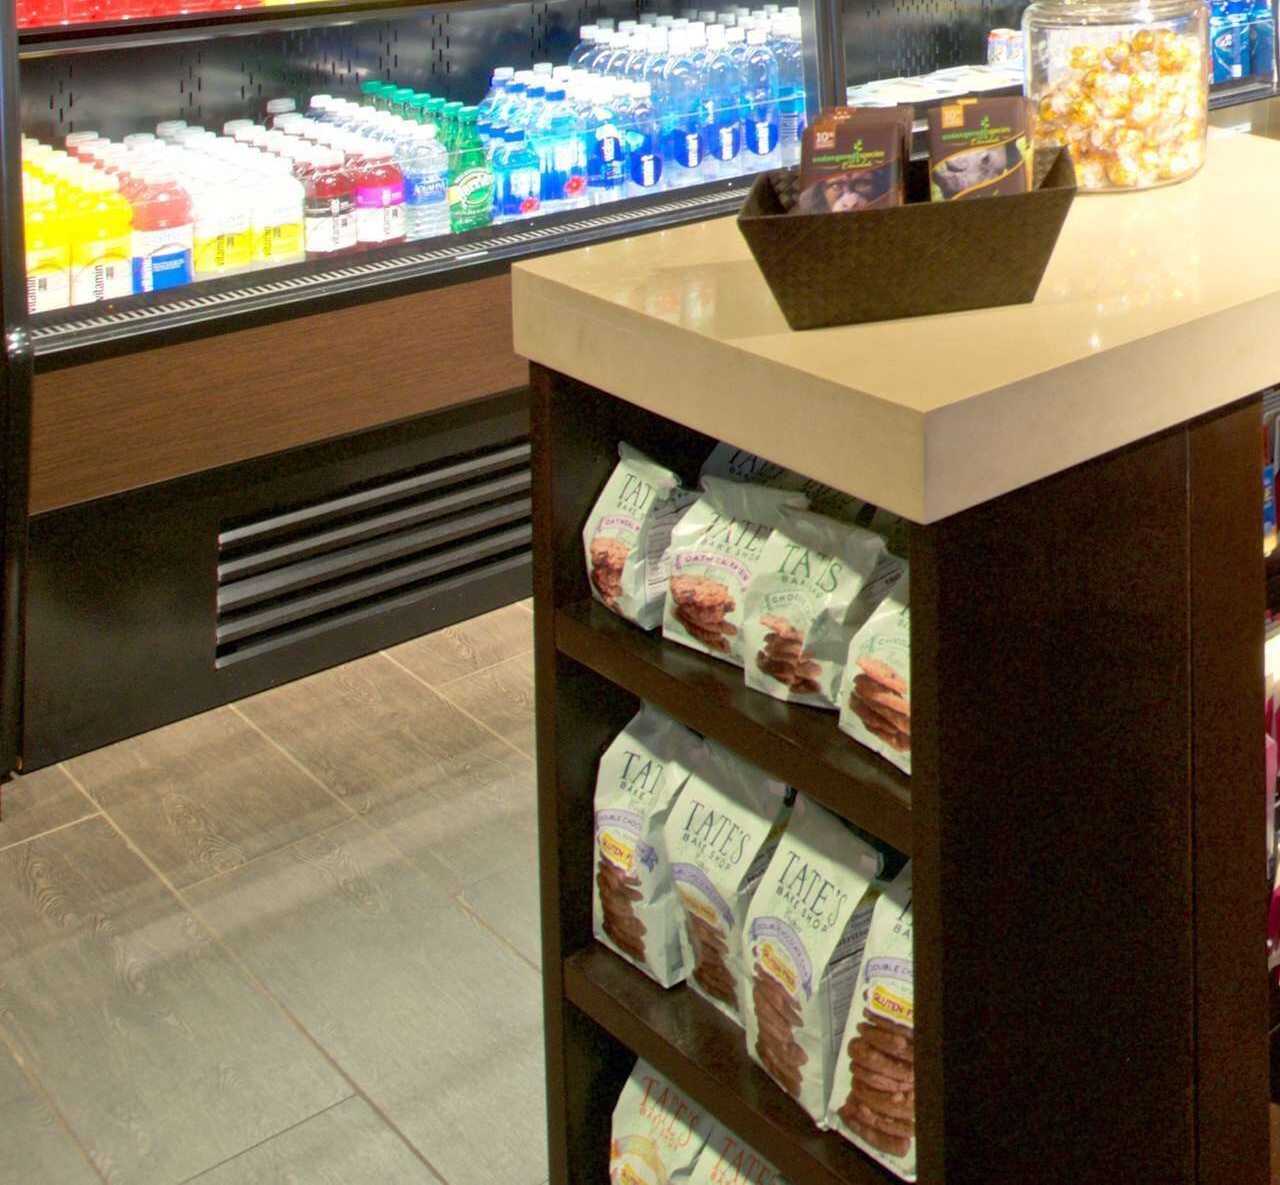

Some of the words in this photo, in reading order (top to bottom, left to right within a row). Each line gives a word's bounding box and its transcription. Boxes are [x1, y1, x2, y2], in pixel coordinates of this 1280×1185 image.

[682, 832, 707, 854] BAKE
[684, 799, 751, 865] TATE'S
[776, 886, 801, 909] BAKE
[777, 850, 848, 927] TATE'S
[873, 993, 904, 1015] GLUTEN
